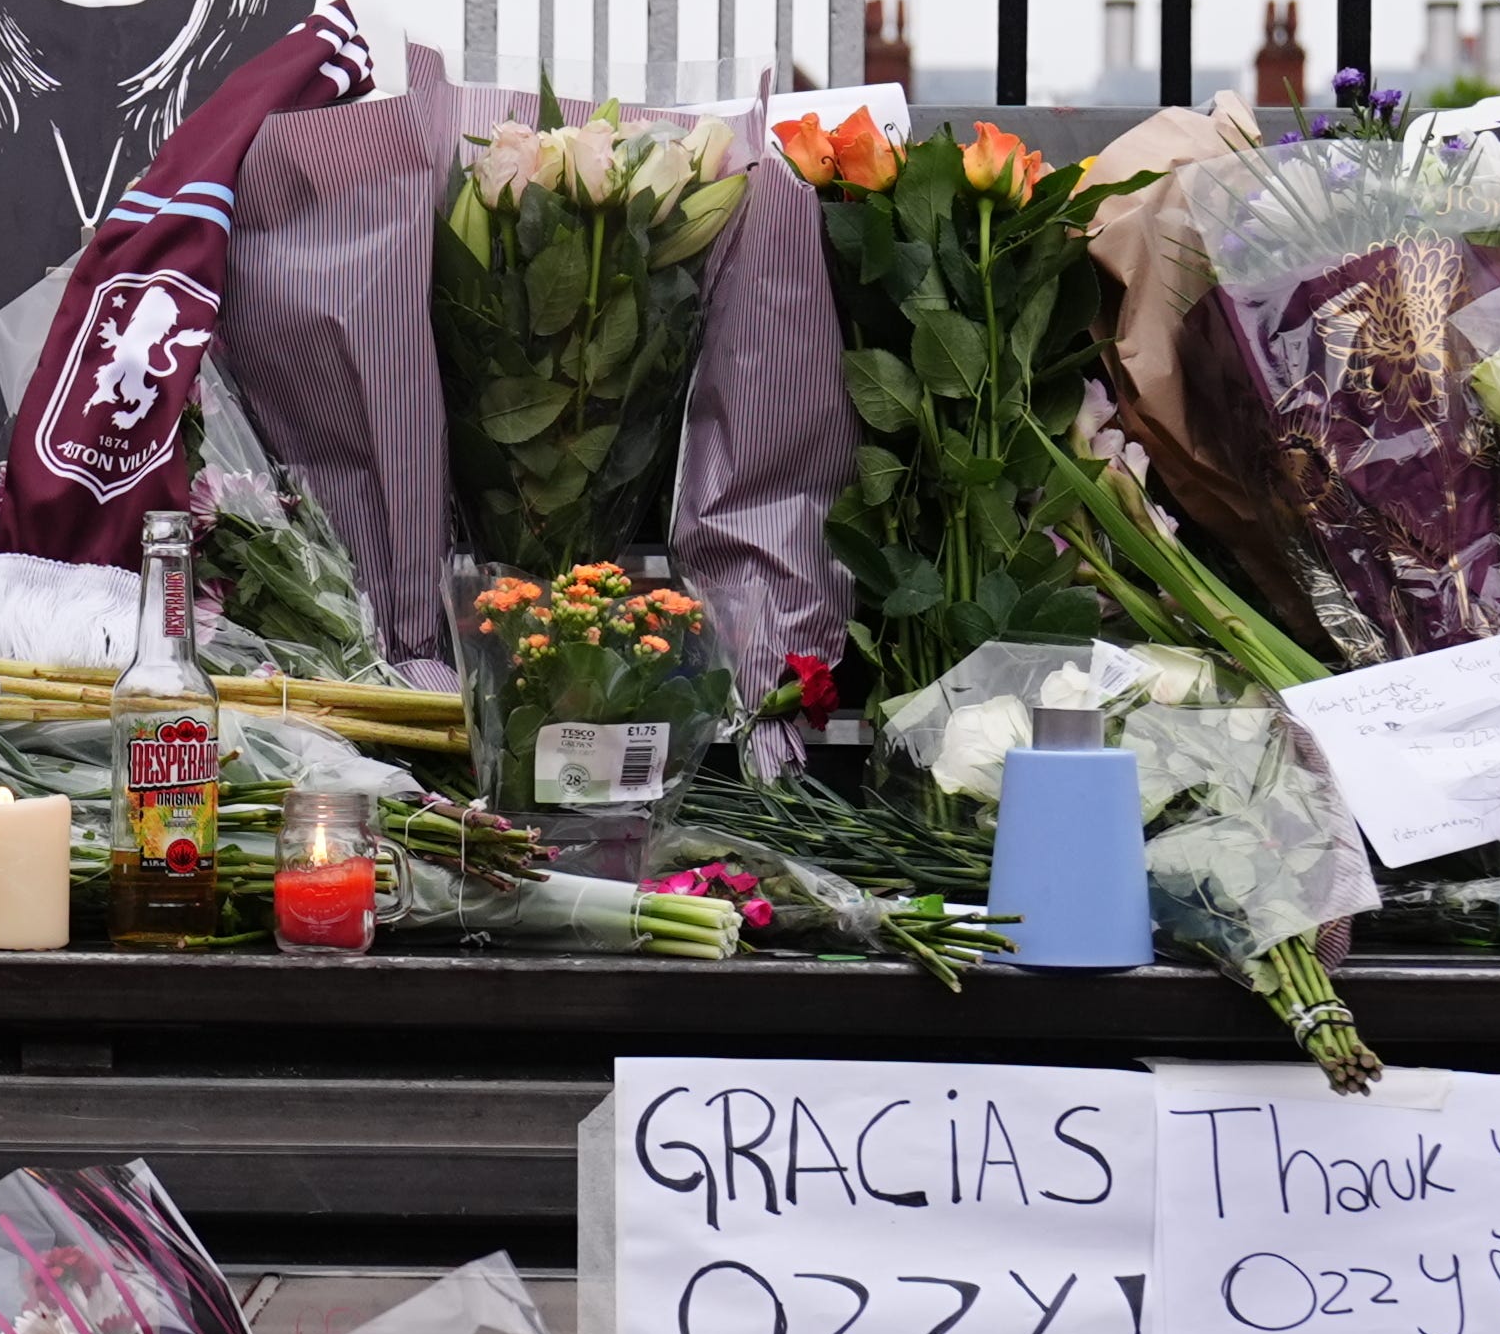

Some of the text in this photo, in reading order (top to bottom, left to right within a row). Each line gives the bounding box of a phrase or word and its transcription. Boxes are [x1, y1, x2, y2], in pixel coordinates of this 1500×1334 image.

[99, 435, 129, 450] 1874
[119, 440, 158, 473] VILLA
[164, 571, 185, 637] DESPERADOS
[561, 728, 596, 737] TESCO
[627, 726, 657, 736] £1.75
[131, 740, 219, 785] DESPERADO
[565, 774, 581, 786] 28
[156, 791, 205, 806] ORIGINAL
[1170, 1103, 1456, 1218] Thank
